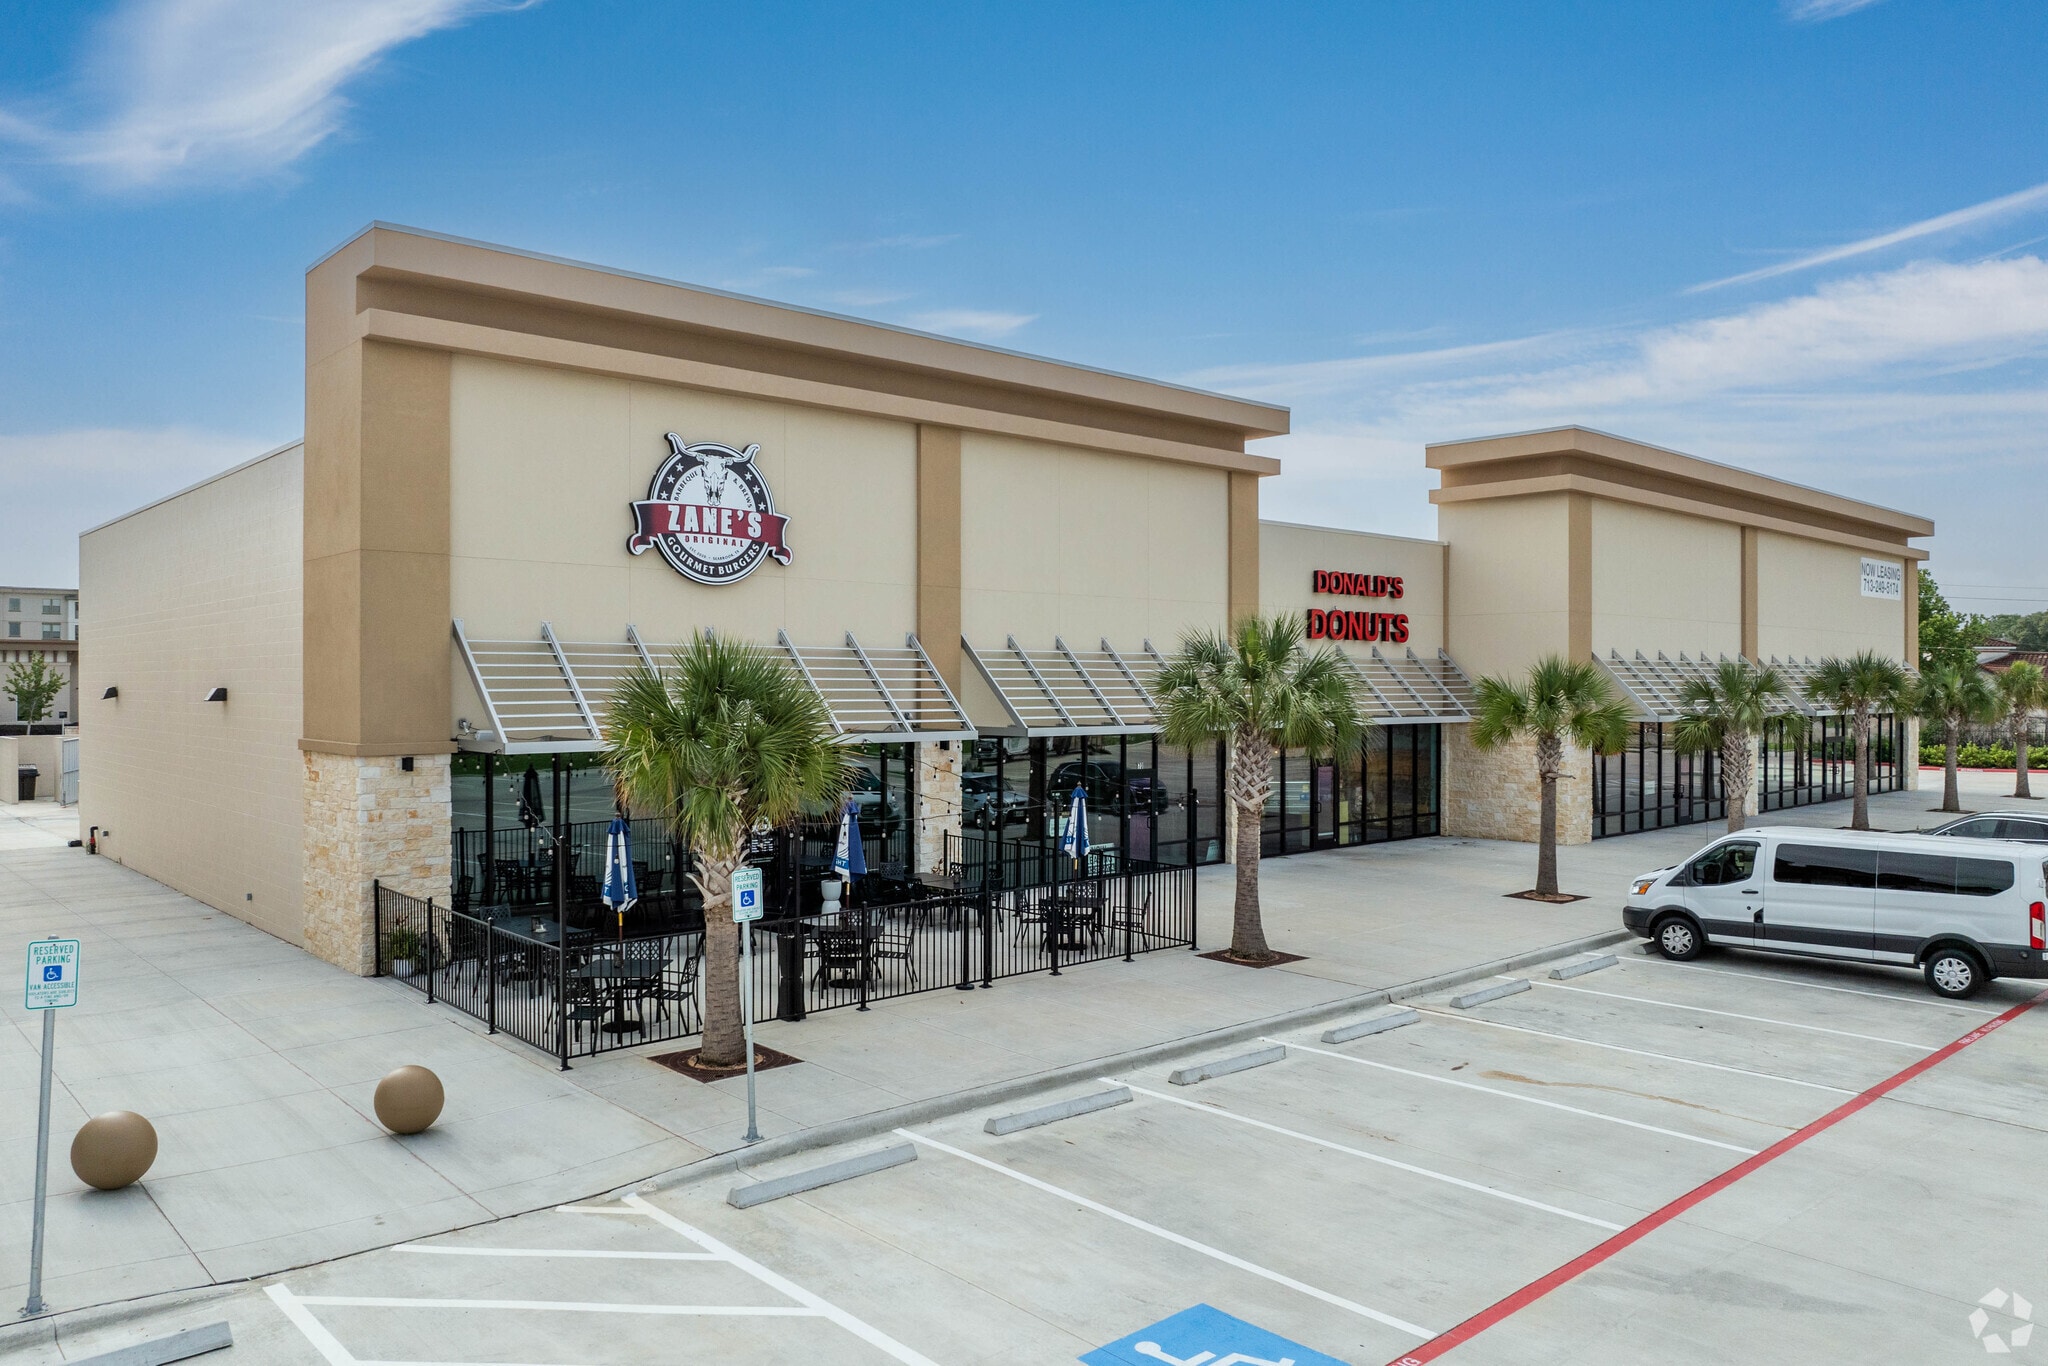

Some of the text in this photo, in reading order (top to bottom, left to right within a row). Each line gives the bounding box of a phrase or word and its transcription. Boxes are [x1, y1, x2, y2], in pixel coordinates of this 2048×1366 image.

[674, 471, 698, 502] BARBEQUE
[739, 485, 753, 509] BREWS
[667, 505, 762, 538] ZANE'S
[685, 535, 744, 548] ORIGINAL
[667, 536, 760, 575] GOURMET BURGERS
[1861, 562, 1901, 581] NOW LEASING
[1314, 570, 1404, 599] DONALD'S
[1307, 609, 1409, 643] DONUTS
[735, 873, 760, 883] RESERVED
[736, 882, 758, 891] PARKING
[33, 944, 75, 956] RESERVED
[36, 955, 71, 965] PARKING
[43, 981, 75, 990] ACCESSIBLE
